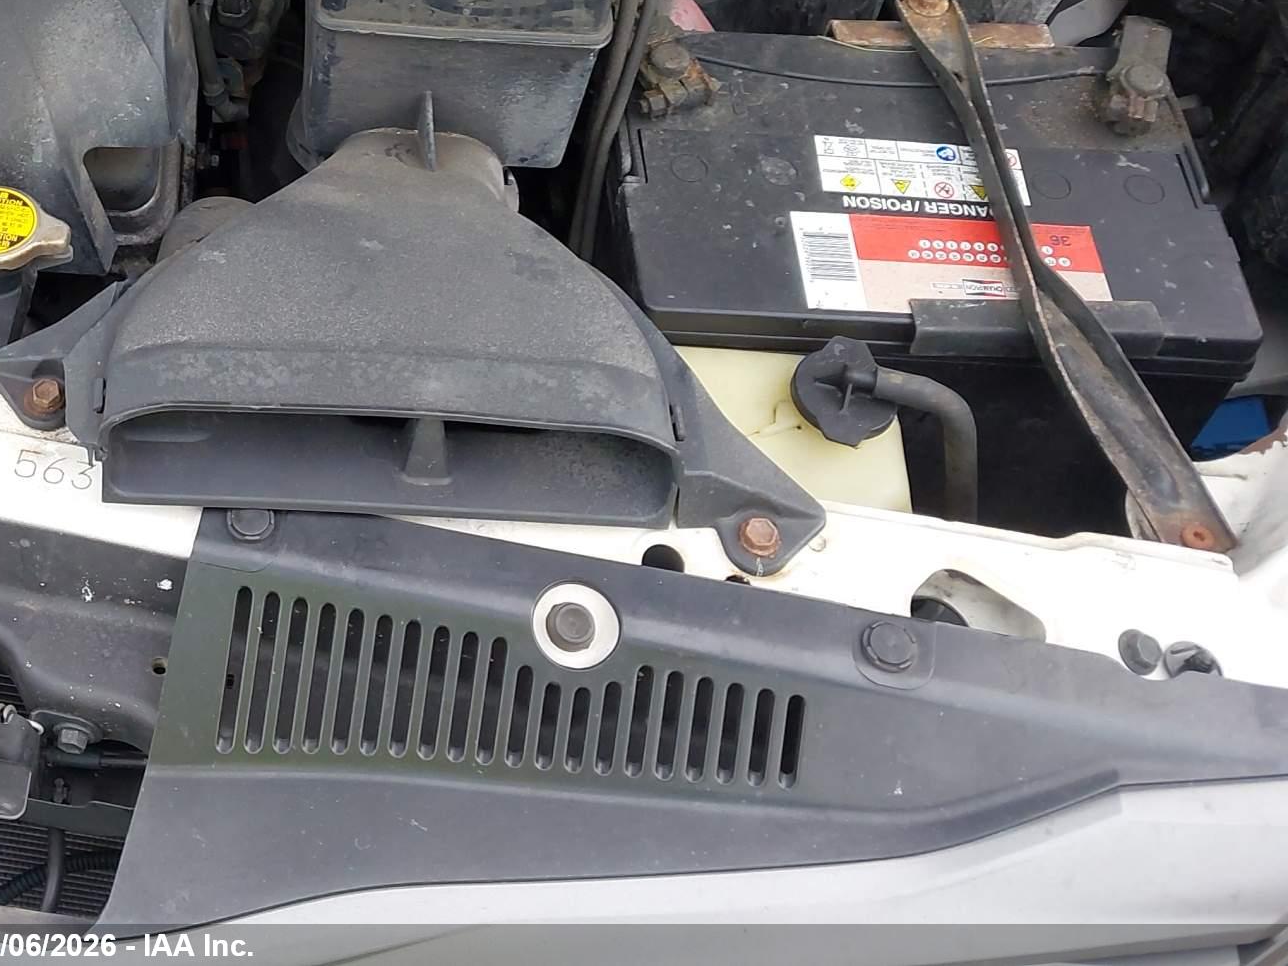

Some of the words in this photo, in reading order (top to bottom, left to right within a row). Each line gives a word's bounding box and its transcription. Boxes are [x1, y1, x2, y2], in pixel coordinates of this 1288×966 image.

[924, 201, 994, 218] ANGER
[1049, 235, 1072, 247] 36
[14, 449, 96, 490] 563
